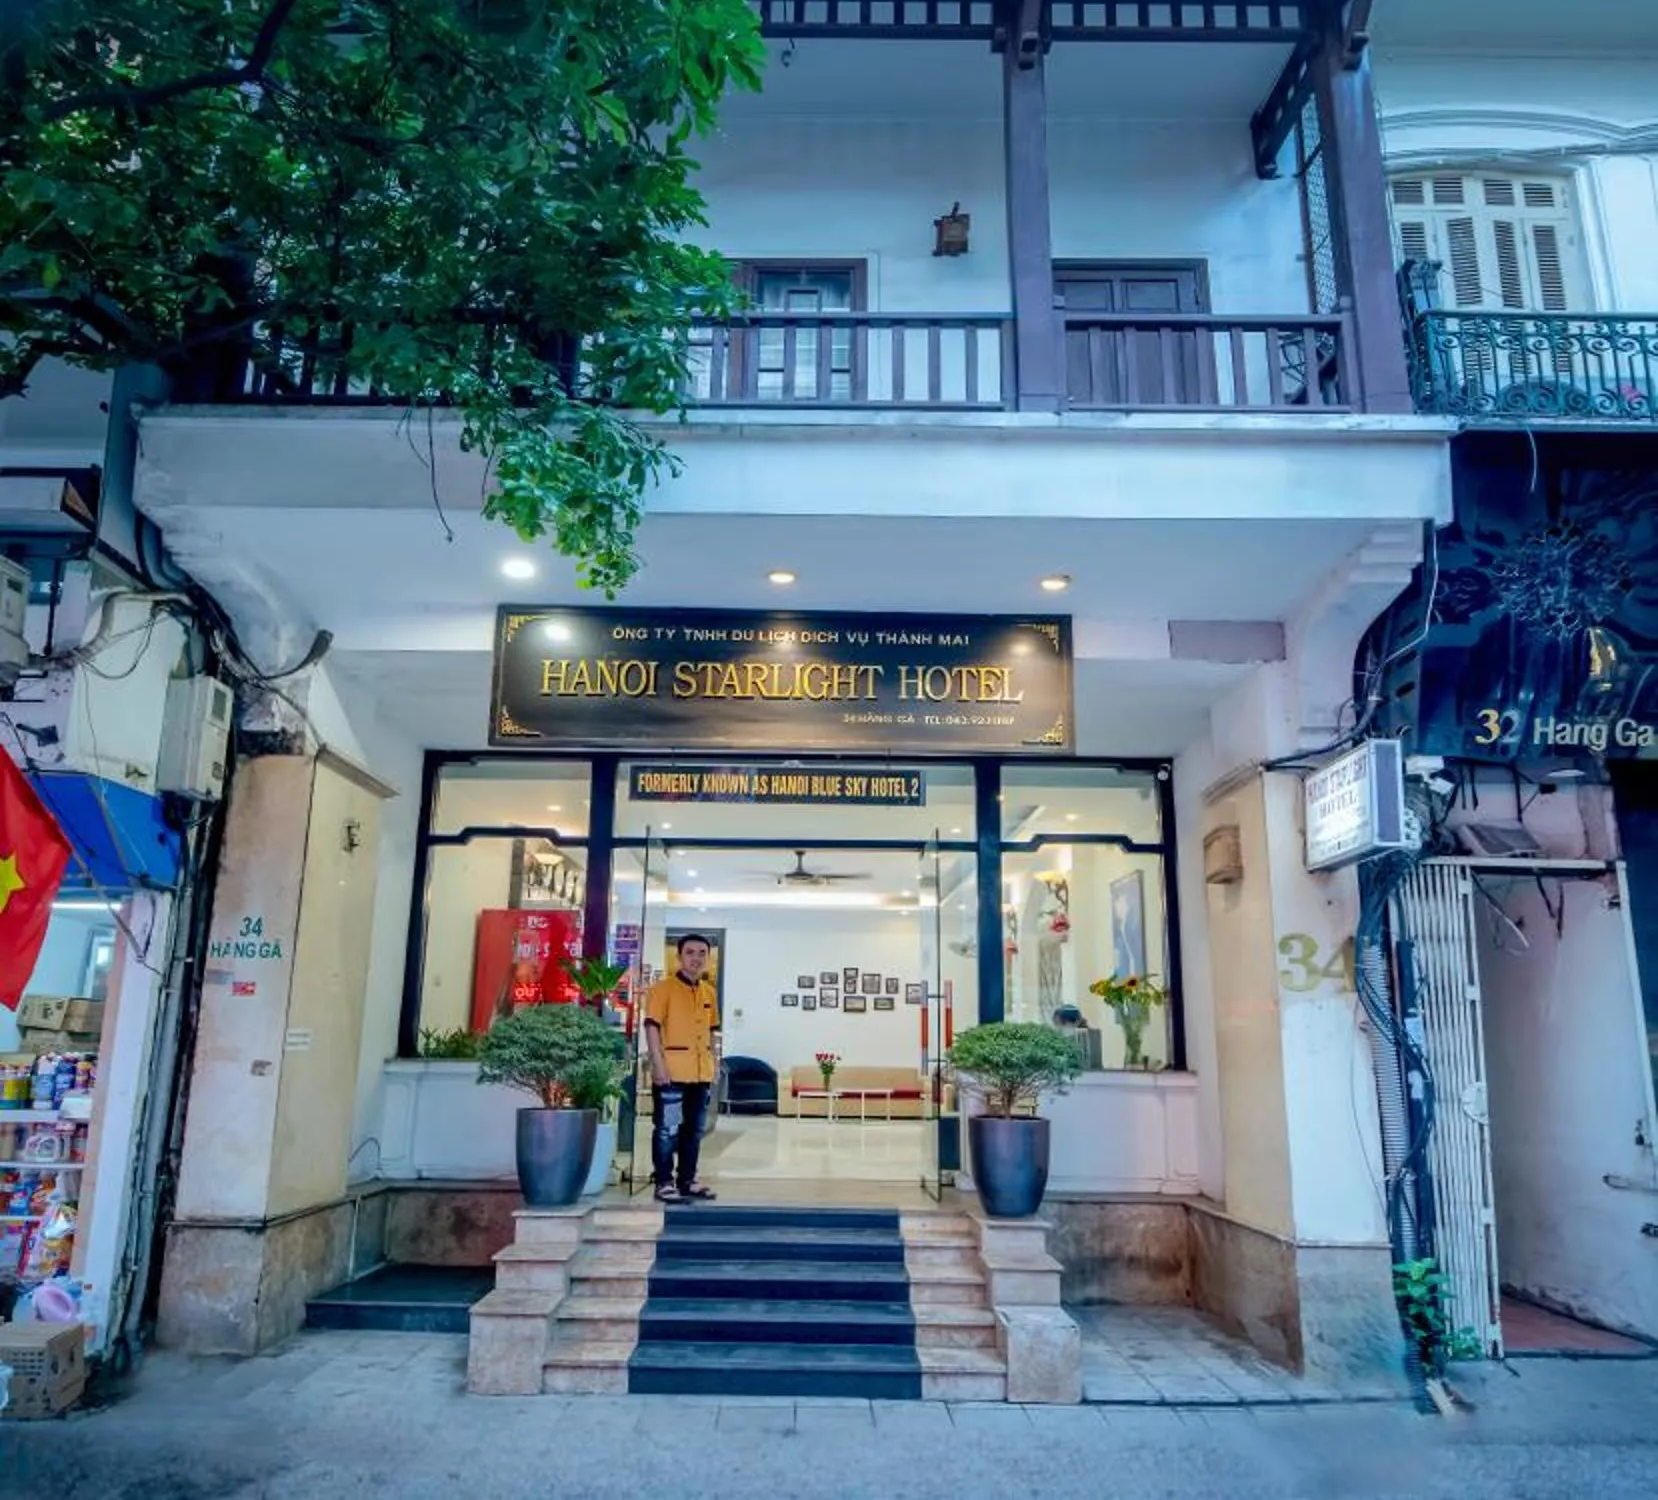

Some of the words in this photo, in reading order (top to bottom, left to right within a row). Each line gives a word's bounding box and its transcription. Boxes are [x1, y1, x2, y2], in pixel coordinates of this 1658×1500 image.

[683, 627, 727, 641] TNHH
[731, 629, 753, 641] DU
[846, 632, 869, 647] VỤ
[938, 633, 970, 646] MAI
[540, 658, 660, 697] HANOI
[672, 661, 885, 700] STARLIGHT
[897, 665, 1025, 702] HOTEL
[1475, 708, 1521, 744] 32
[1533, 716, 1608, 751] Hang
[1615, 718, 1654, 747] Ga
[638, 772, 700, 793] FORMERLY
[702, 773, 749, 794] KNOWN
[752, 775, 769, 795] AS
[771, 775, 809, 795] HANOI
[811, 776, 842, 796] BLUE
[845, 776, 868, 797] SKY
[871, 777, 908, 797] HOTEL
[911, 778, 919, 797] 2
[239, 915, 263, 937] 34
[1278, 932, 1357, 993] 34
